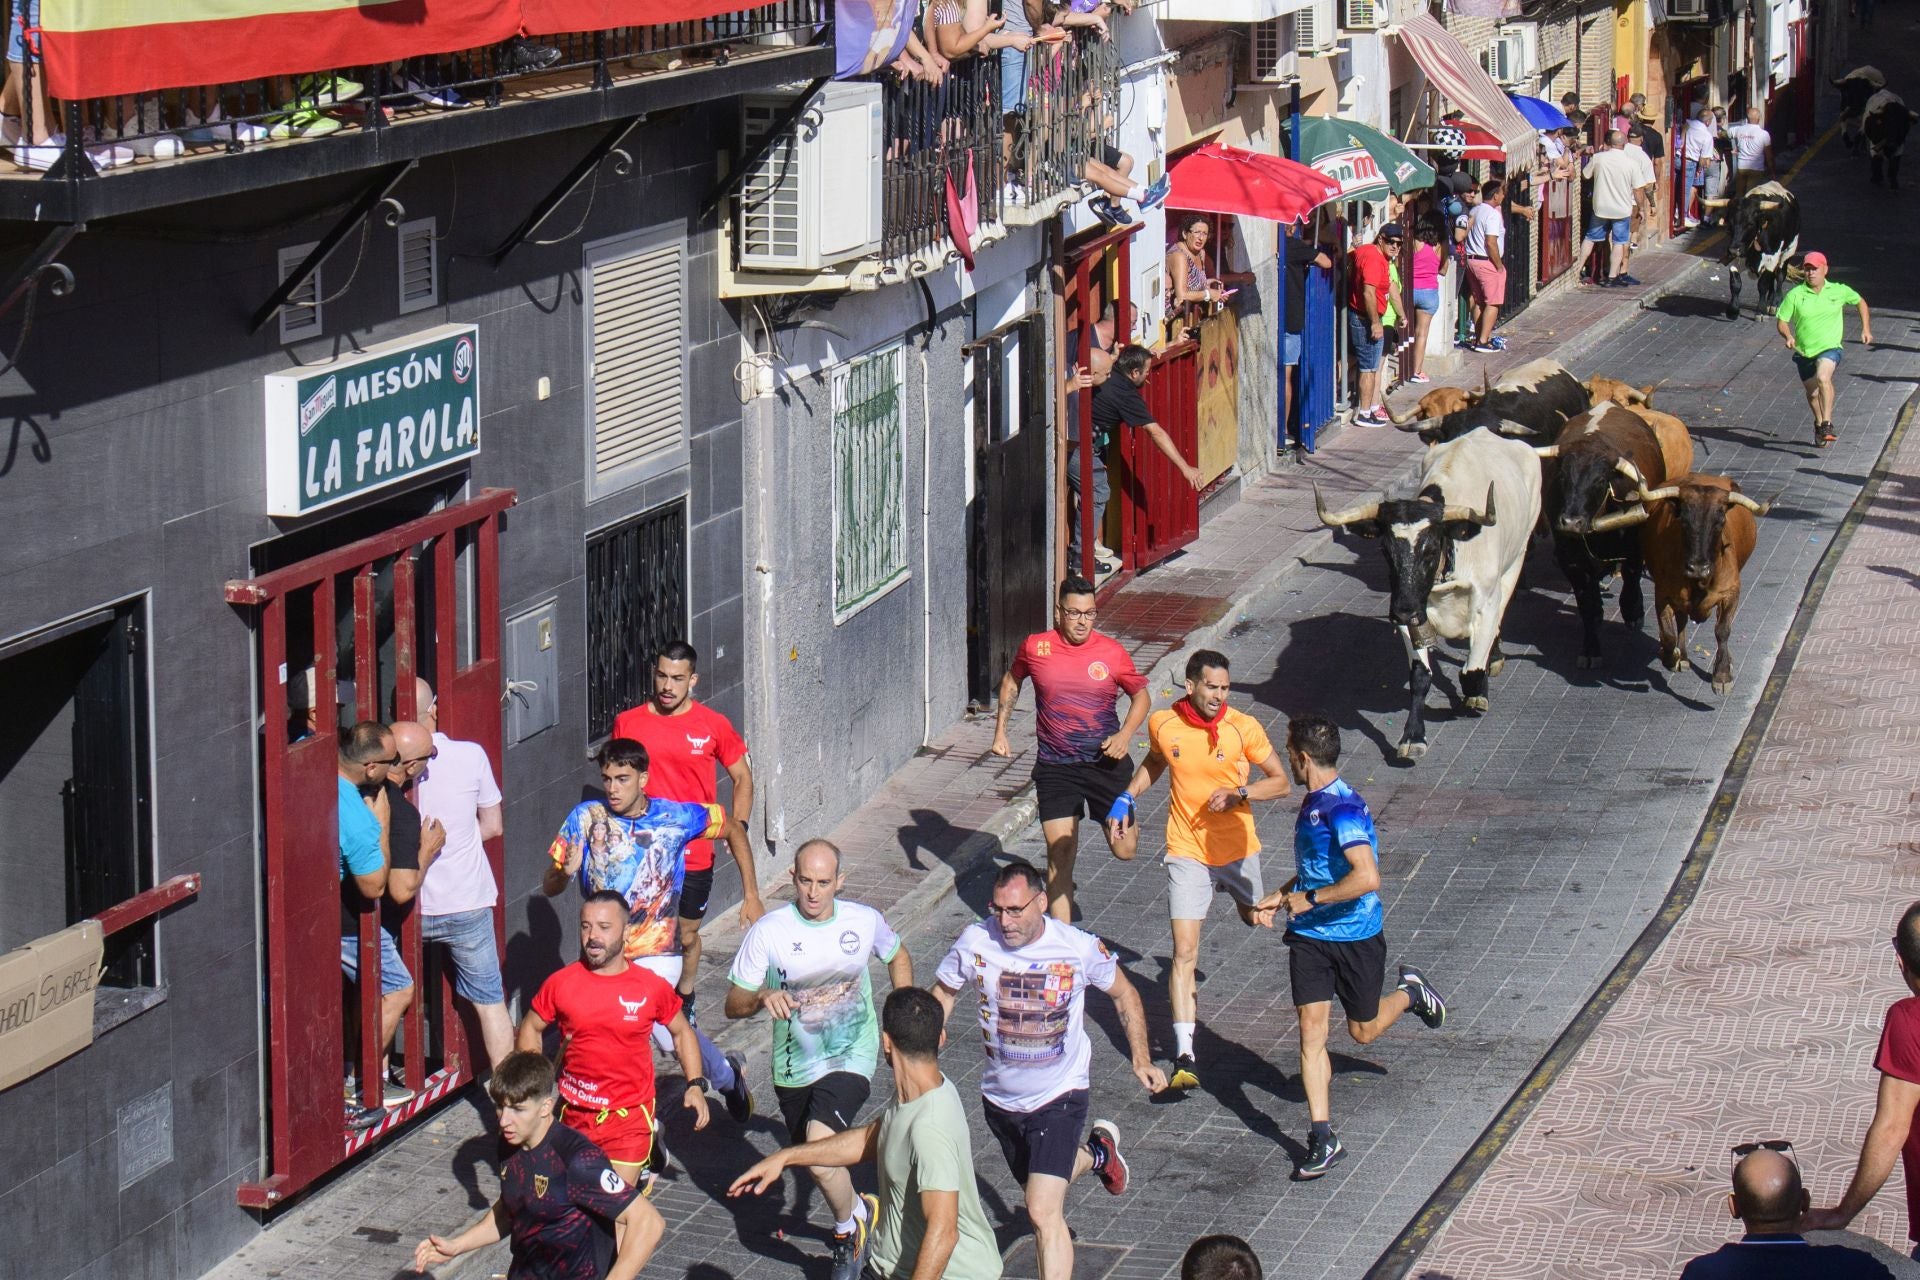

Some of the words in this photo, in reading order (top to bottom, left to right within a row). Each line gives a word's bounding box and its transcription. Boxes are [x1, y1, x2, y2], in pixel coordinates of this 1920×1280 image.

[345, 353, 442, 408] MESÓN
[306, 438, 342, 498] LA
[356, 396, 473, 482] FAROLA
